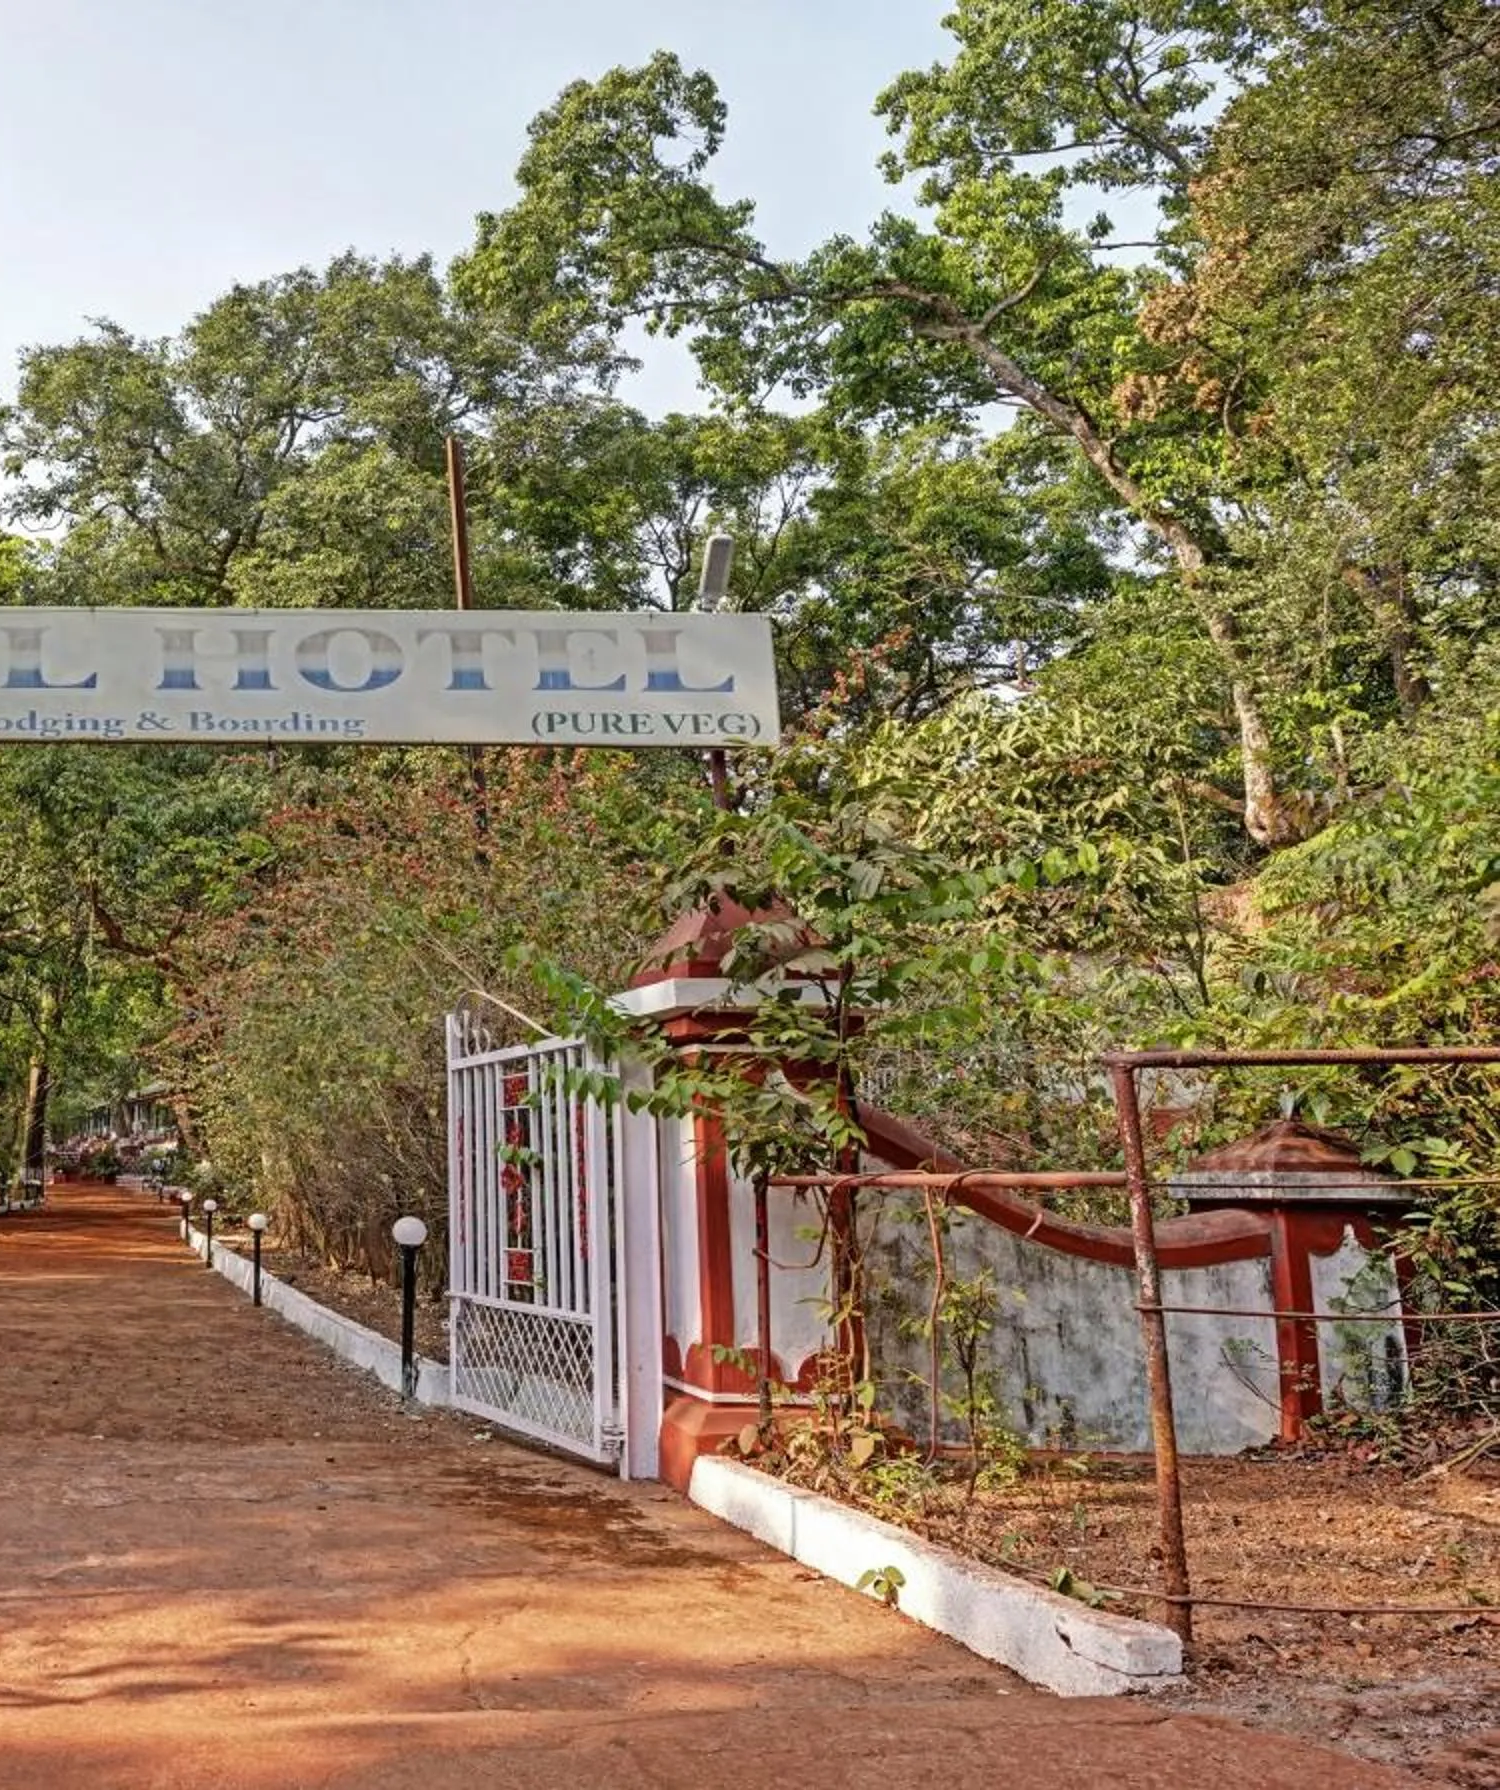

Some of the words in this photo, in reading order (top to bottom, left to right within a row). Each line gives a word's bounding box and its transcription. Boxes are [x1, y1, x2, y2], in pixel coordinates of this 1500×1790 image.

[155, 626, 735, 692] HOTEL
[136, 711, 176, 732] &
[188, 710, 367, 737] Boarding
